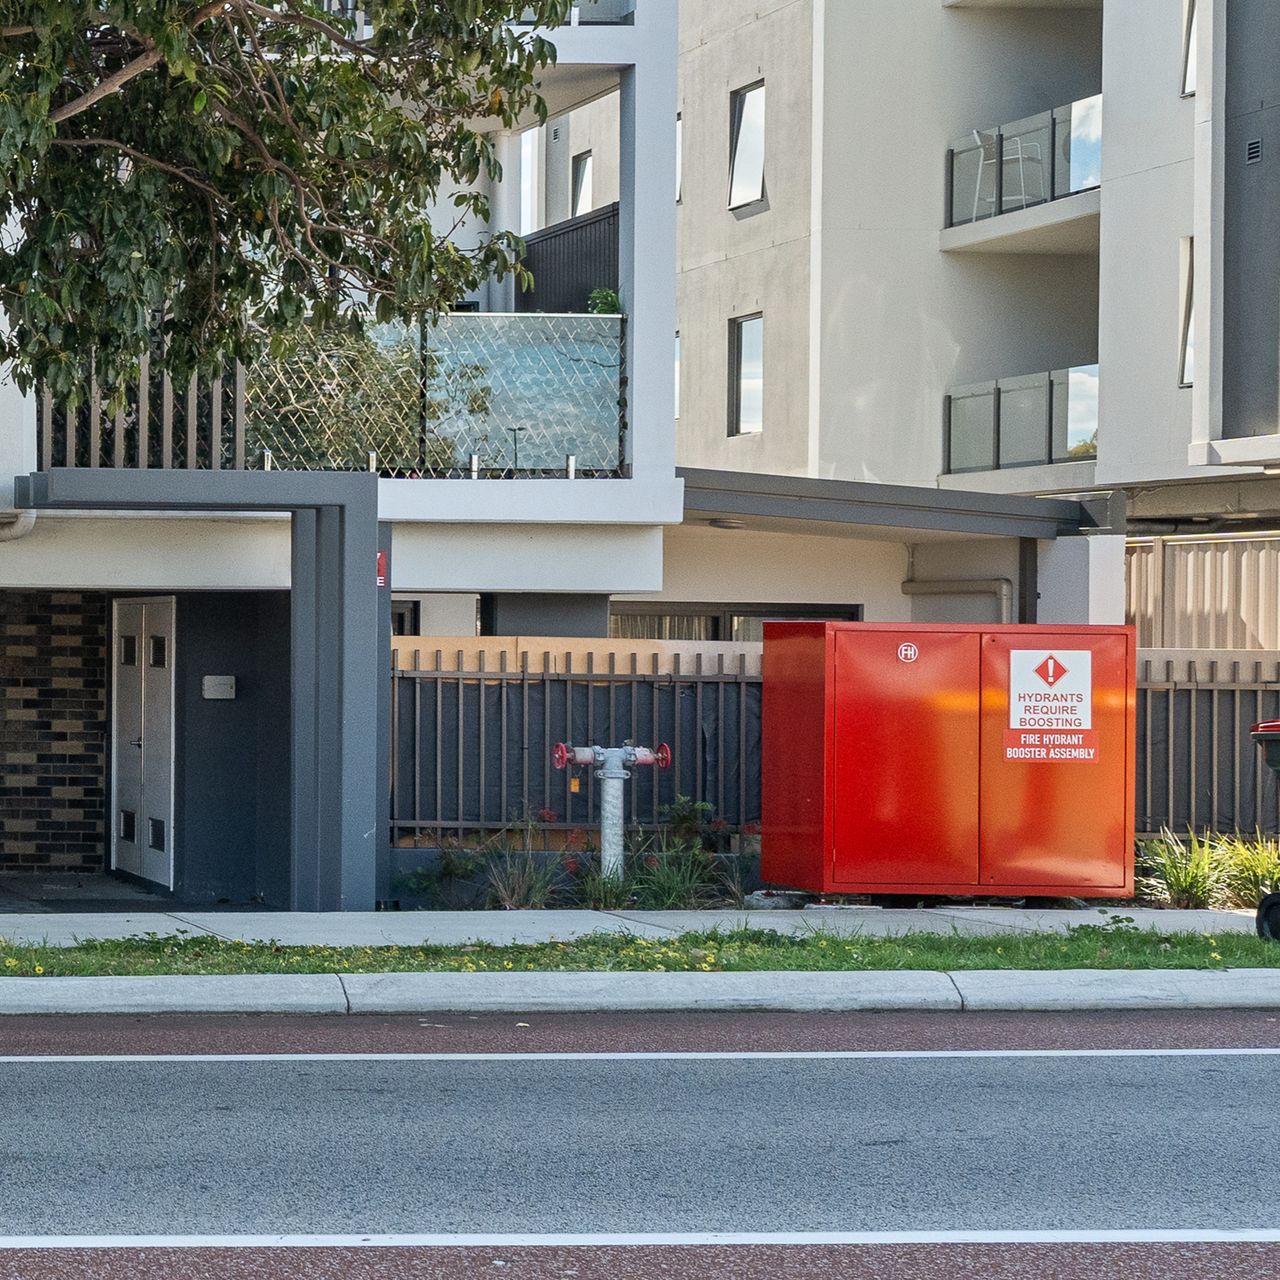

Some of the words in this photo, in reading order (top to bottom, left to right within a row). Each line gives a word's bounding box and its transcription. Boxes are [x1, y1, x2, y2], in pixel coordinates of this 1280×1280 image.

[901, 646, 915, 659] FH
[1018, 693, 1083, 703] HYDRANTS
[1024, 705, 1077, 715] REQUIRE
[1019, 717, 1082, 727] BOOSTING
[1020, 734, 1040, 744] FIRE
[1043, 734, 1083, 745] HYDRANT
[1006, 748, 1047, 758] BOOSTER
[1049, 748, 1095, 759] ASSEMBLY
